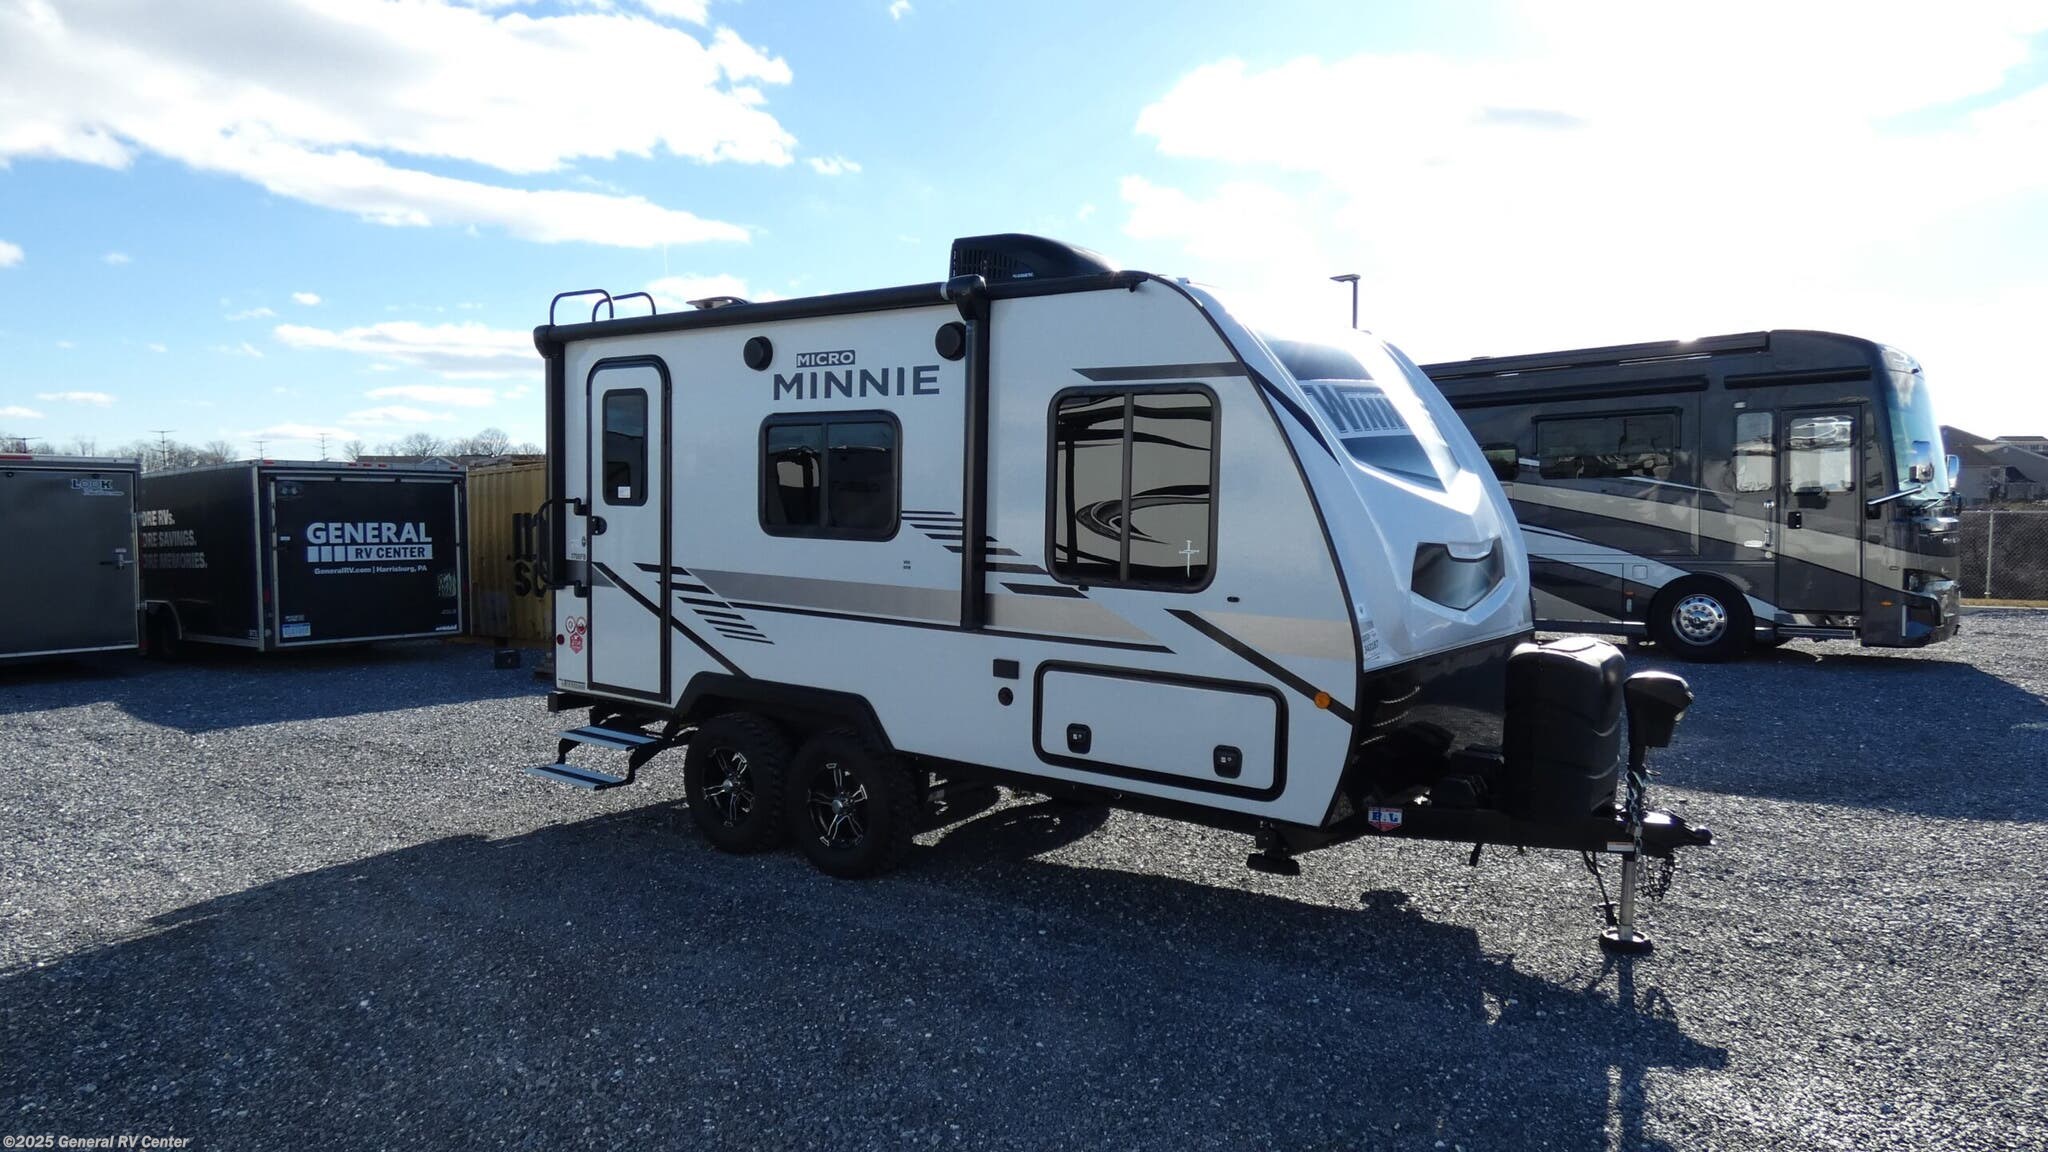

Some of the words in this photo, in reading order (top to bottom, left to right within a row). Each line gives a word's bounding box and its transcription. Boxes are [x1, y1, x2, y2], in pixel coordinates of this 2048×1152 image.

[796, 351, 855, 366] MICRO
[773, 365, 940, 401] MINNIE
[71, 479, 113, 490] LOOK
[142, 510, 158, 526] ORE
[142, 531, 158, 547] ORE
[306, 522, 433, 544] GENERAL
[142, 552, 158, 569] ORE
[355, 548, 373, 559] RV
[376, 546, 426, 558] CENTER
[314, 567, 372, 575] GeneralRV.com
[418, 564, 428, 572] PA
